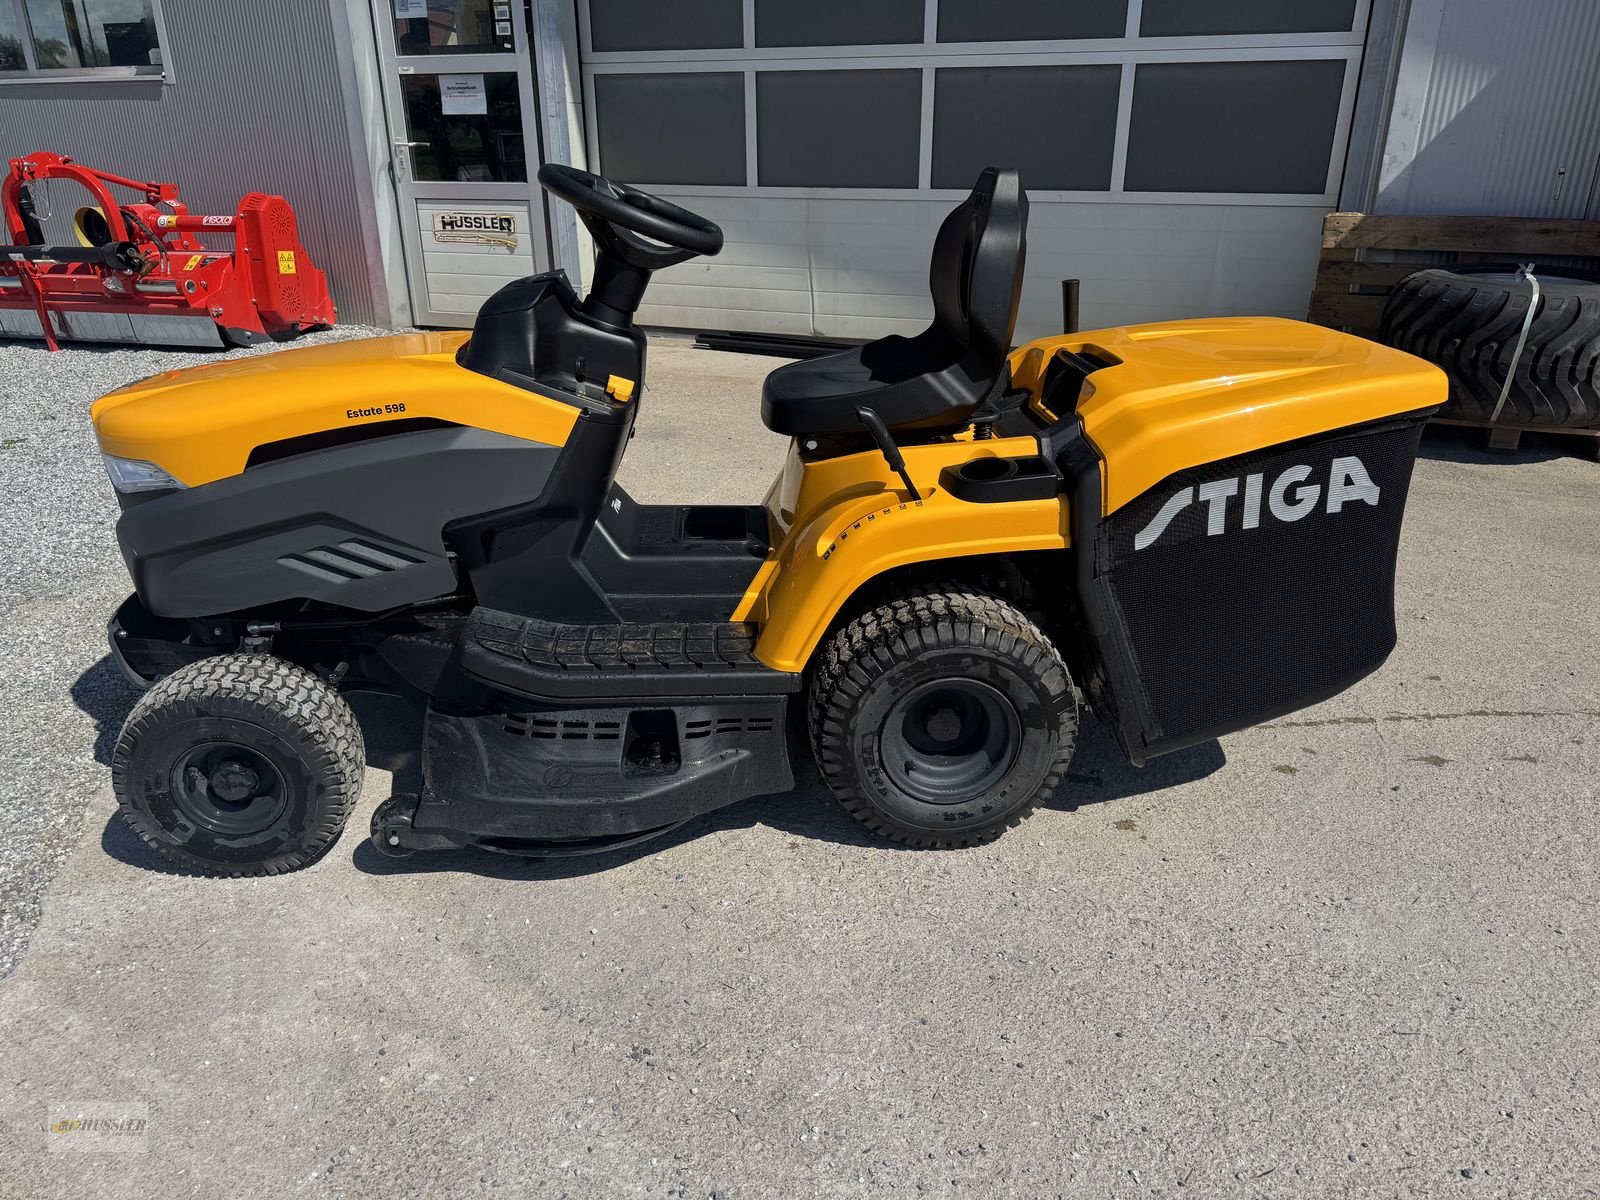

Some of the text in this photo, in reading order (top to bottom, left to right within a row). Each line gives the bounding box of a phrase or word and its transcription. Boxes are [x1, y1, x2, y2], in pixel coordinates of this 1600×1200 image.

[346, 403, 406, 419] Estate 598
[1134, 456, 1380, 551] STIGA
